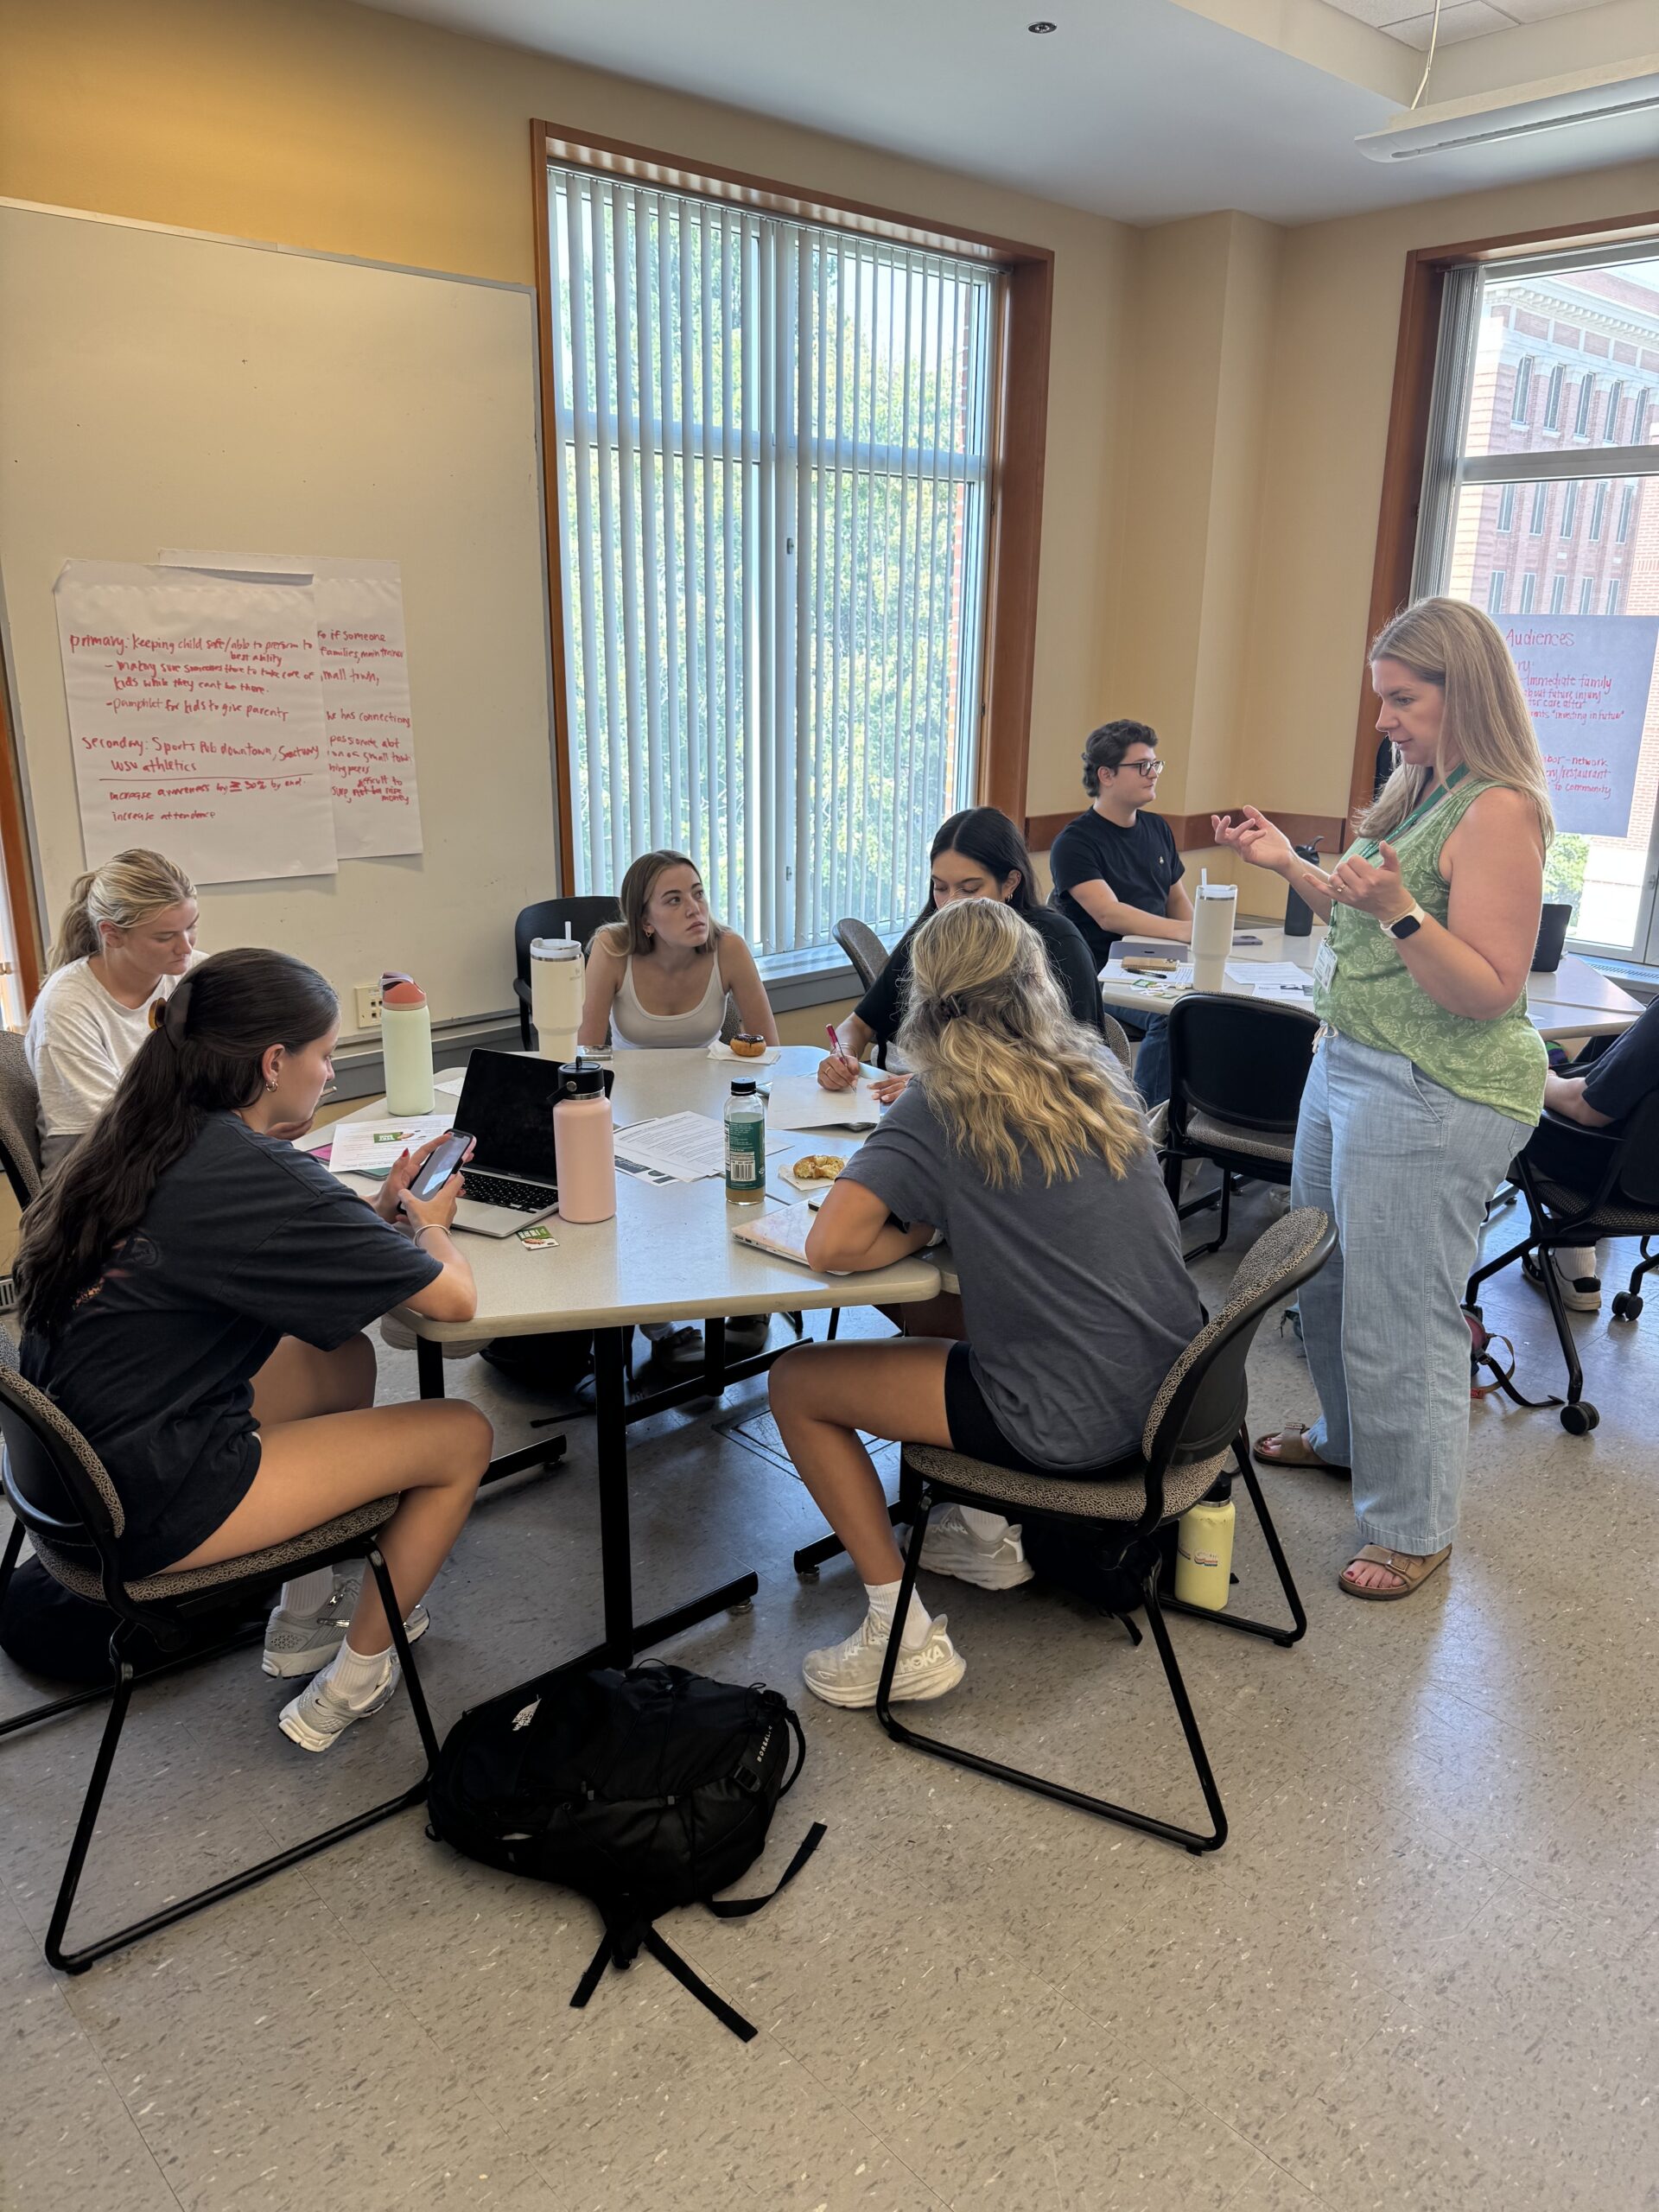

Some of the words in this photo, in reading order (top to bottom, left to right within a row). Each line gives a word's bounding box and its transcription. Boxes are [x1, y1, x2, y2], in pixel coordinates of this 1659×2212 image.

[1505, 628, 1575, 647] Audiences
[70, 634, 129, 656] primary:
[178, 638, 202, 650] child
[303, 639, 313, 650] to
[230, 652, 250, 661] best
[252, 654, 282, 667] ability
[247, 665, 257, 675] to
[173, 678, 194, 692] they
[1579, 673, 1613, 695] family
[208, 700, 219, 711] to
[340, 709, 355, 720] has
[143, 757, 197, 772] athletics
[1572, 757, 1609, 766] network
[270, 779, 282, 791] by
[392, 776, 403, 785] to
[898, 1644, 945, 1674] HOKA
